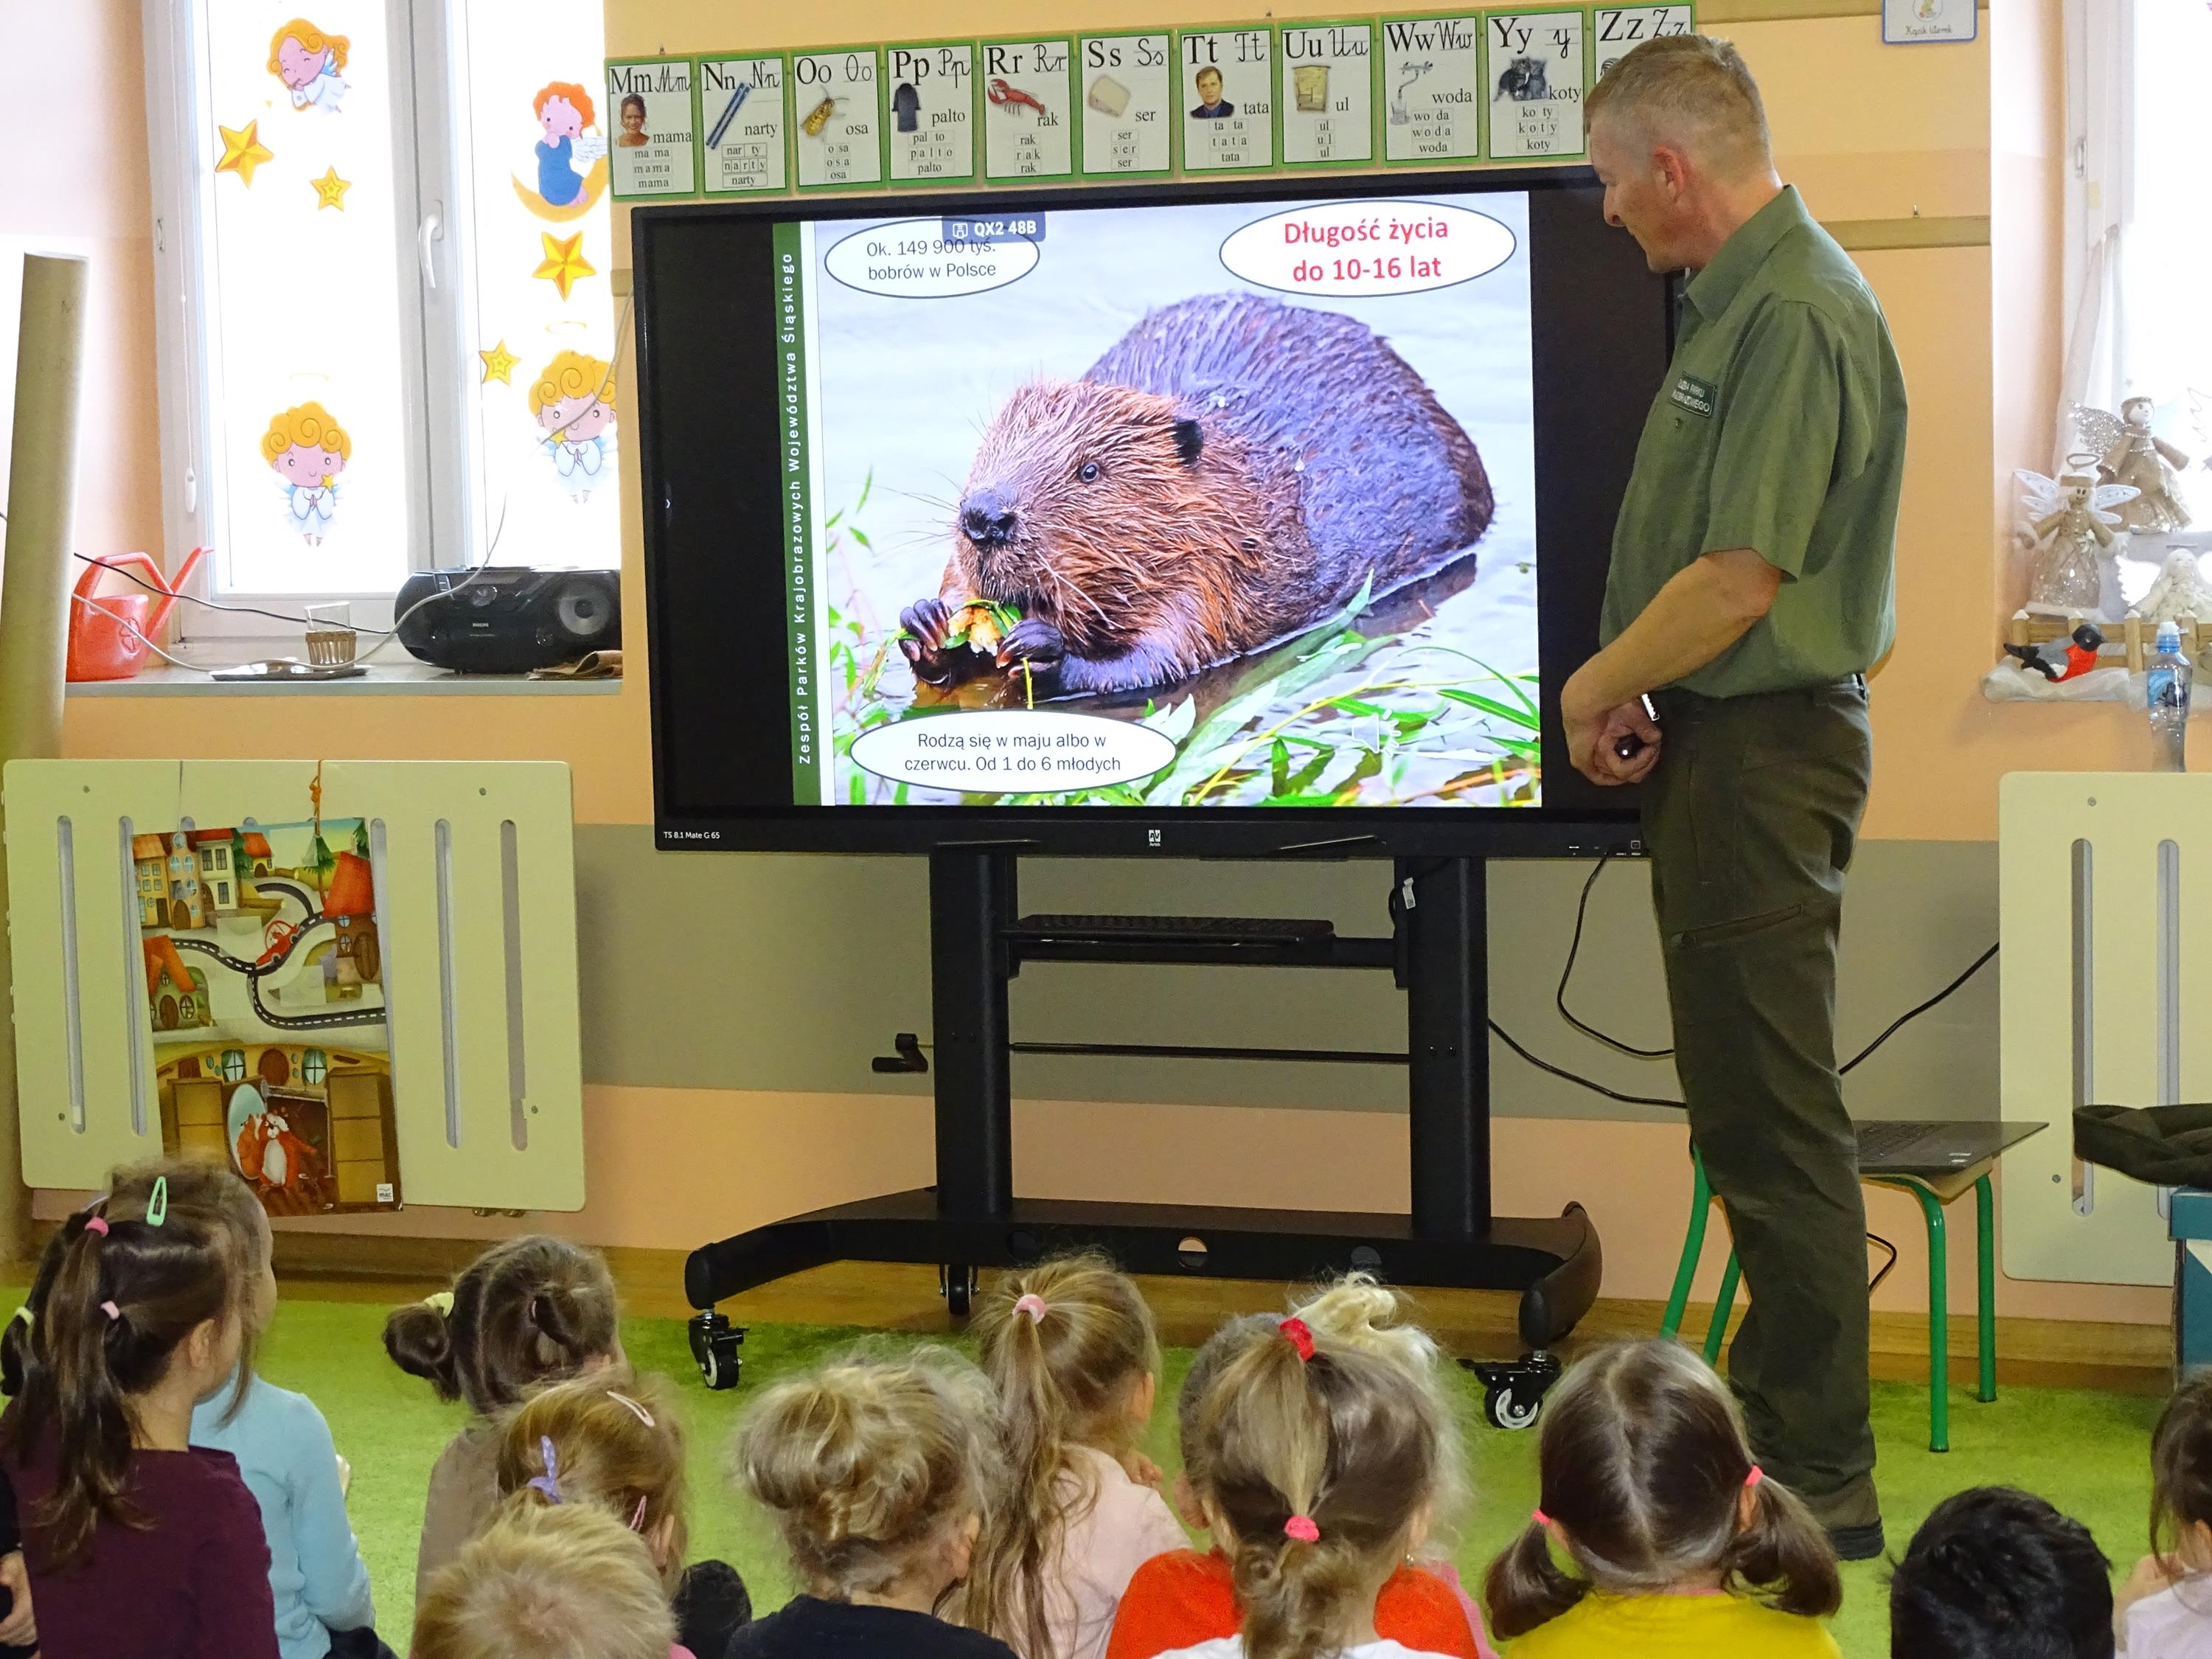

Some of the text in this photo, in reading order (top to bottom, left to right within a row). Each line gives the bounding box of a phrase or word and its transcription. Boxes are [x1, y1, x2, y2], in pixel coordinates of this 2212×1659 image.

[1386, 23, 1434, 53] Ww
[1492, 18, 1533, 55] Yy
[1184, 36, 1218, 64] Tt
[1285, 32, 1324, 59] Uu
[987, 47, 1023, 74] Rr
[796, 58, 832, 84] Oo
[893, 51, 930, 86] Pp
[611, 67, 653, 94] Mm
[703, 63, 735, 91] Nn
[1432, 88, 1472, 104] woda
[1549, 86, 1582, 102] koty
[1244, 102, 1269, 114] tata
[1335, 98, 1349, 111] ul
[932, 110, 965, 125] palto
[1037, 114, 1059, 127] rak
[1135, 110, 1156, 122] ser
[745, 122, 778, 137] narty
[846, 123, 869, 135] osa
[1118, 131, 1132, 140] ser
[653, 131, 692, 143] mama
[1020, 135, 1035, 145] rak
[1320, 147, 1329, 157] ul
[1419, 142, 1447, 153] woda
[1527, 139, 1551, 151] koty
[1118, 159, 1132, 167] ser
[1222, 153, 1239, 161] tata
[830, 171, 846, 179] osa
[918, 163, 942, 174] palto
[1021, 163, 1036, 173] rak
[639, 178, 669, 188] mama
[731, 175, 755, 186] narty
[974, 221, 1037, 236] QX2 48B
[1285, 217, 1448, 247] Długość życia
[867, 237, 996, 257] Ok. 149 900 tyś.
[869, 263, 996, 280] bobrów w Polsce
[1293, 256, 1441, 282] do 10-16 lat
[782, 254, 811, 765] Zespół Parków Krajobrazowych Województwa Śląskiego
[918, 733, 1106, 751] Rodzą się w maju albo w
[905, 757, 1121, 774] czerwcu. Od 1 do 6 młodych
